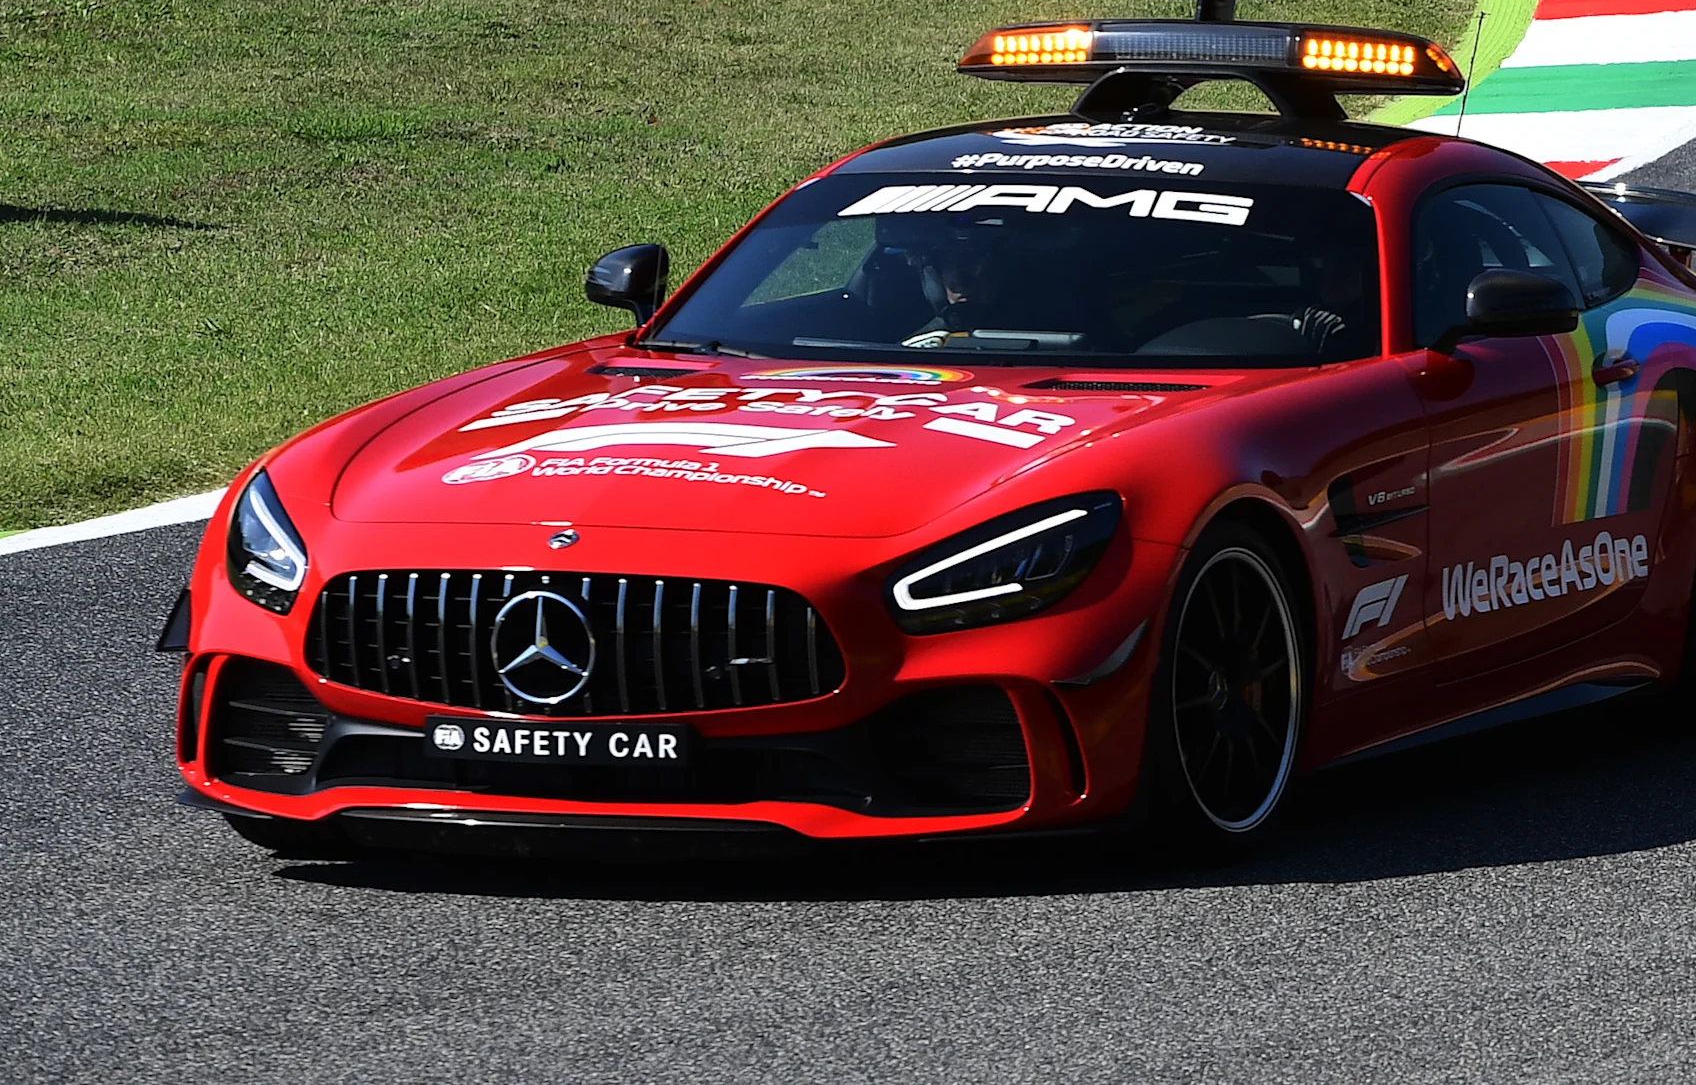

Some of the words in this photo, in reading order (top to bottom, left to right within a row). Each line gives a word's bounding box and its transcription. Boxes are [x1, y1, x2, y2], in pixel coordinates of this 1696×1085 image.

[951, 152, 1205, 176] #PurposeDriven
[947, 184, 1254, 226] AMG
[531, 465, 611, 477] World
[587, 456, 703, 471] Formula
[1442, 531, 1649, 621] WeRaceAsOne
[473, 726, 593, 757] SAFETY
[608, 732, 678, 759] CAR
